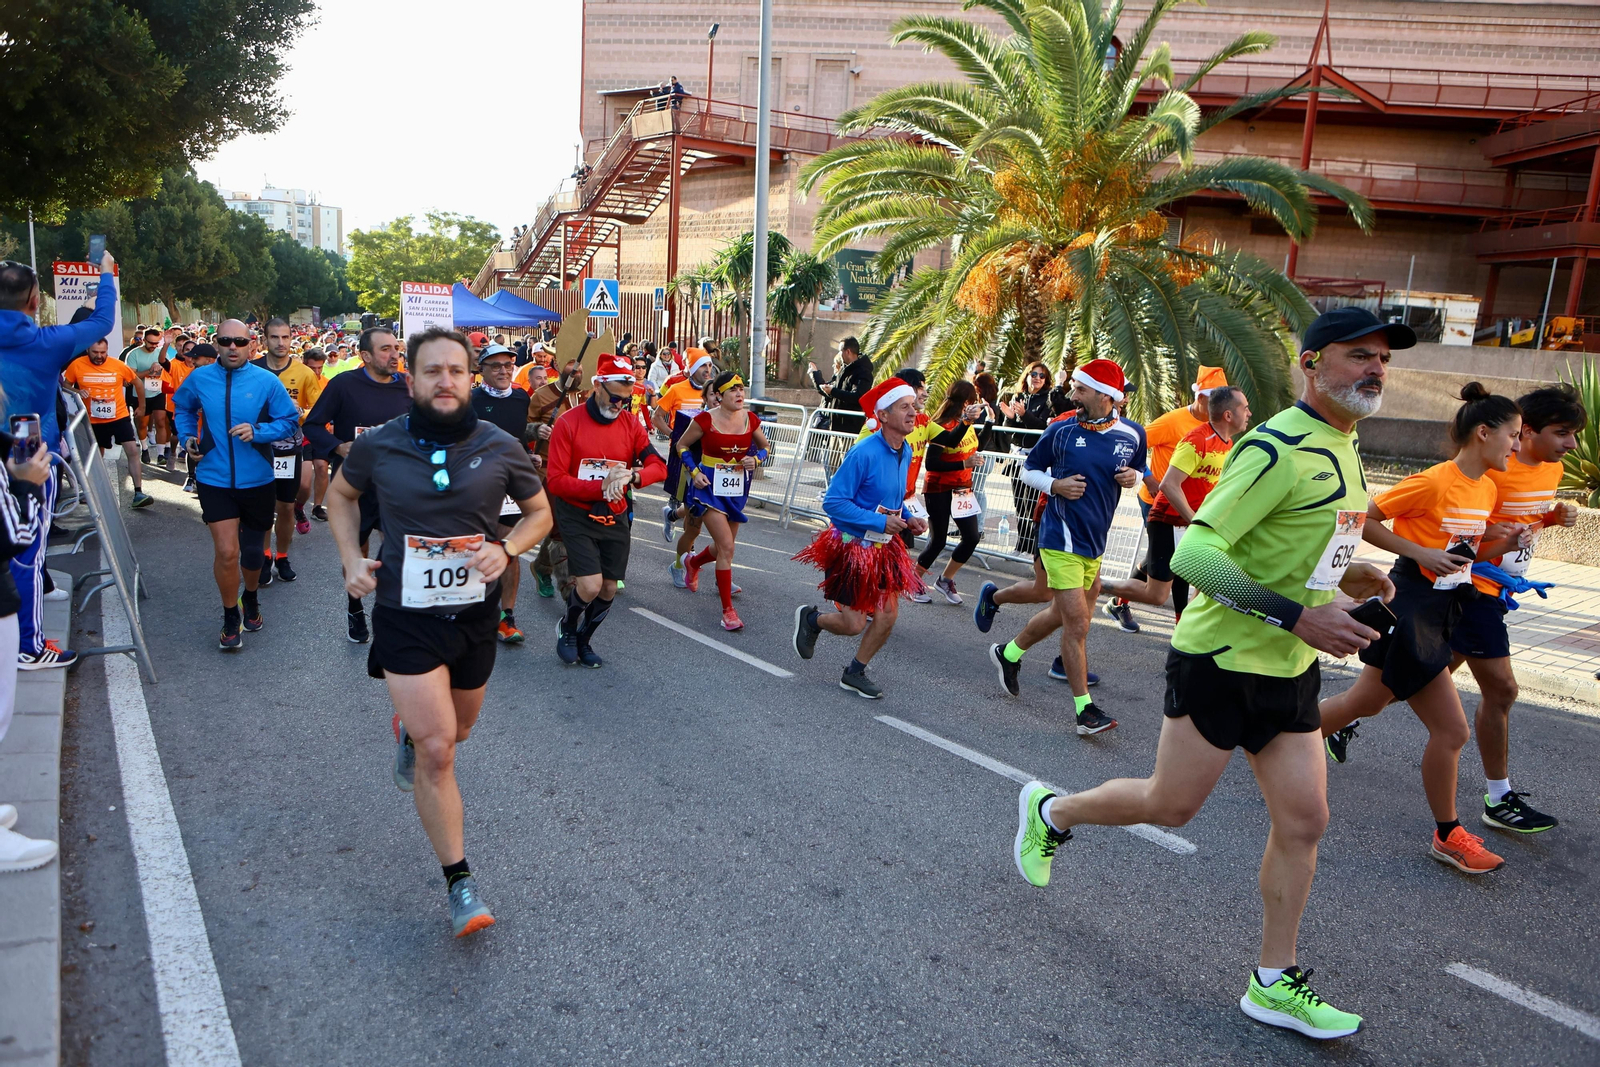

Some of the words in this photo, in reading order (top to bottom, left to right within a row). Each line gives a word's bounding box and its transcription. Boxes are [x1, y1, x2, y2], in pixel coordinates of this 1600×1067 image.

[846, 260, 864, 272] Gran
[59, 277, 79, 286] XII
[405, 283, 450, 295] SALIDA
[407, 295, 422, 304] XII
[96, 406, 112, 414] 448
[722, 477, 740, 488] 844
[1331, 544, 1355, 569] 609
[423, 566, 469, 589] 109
